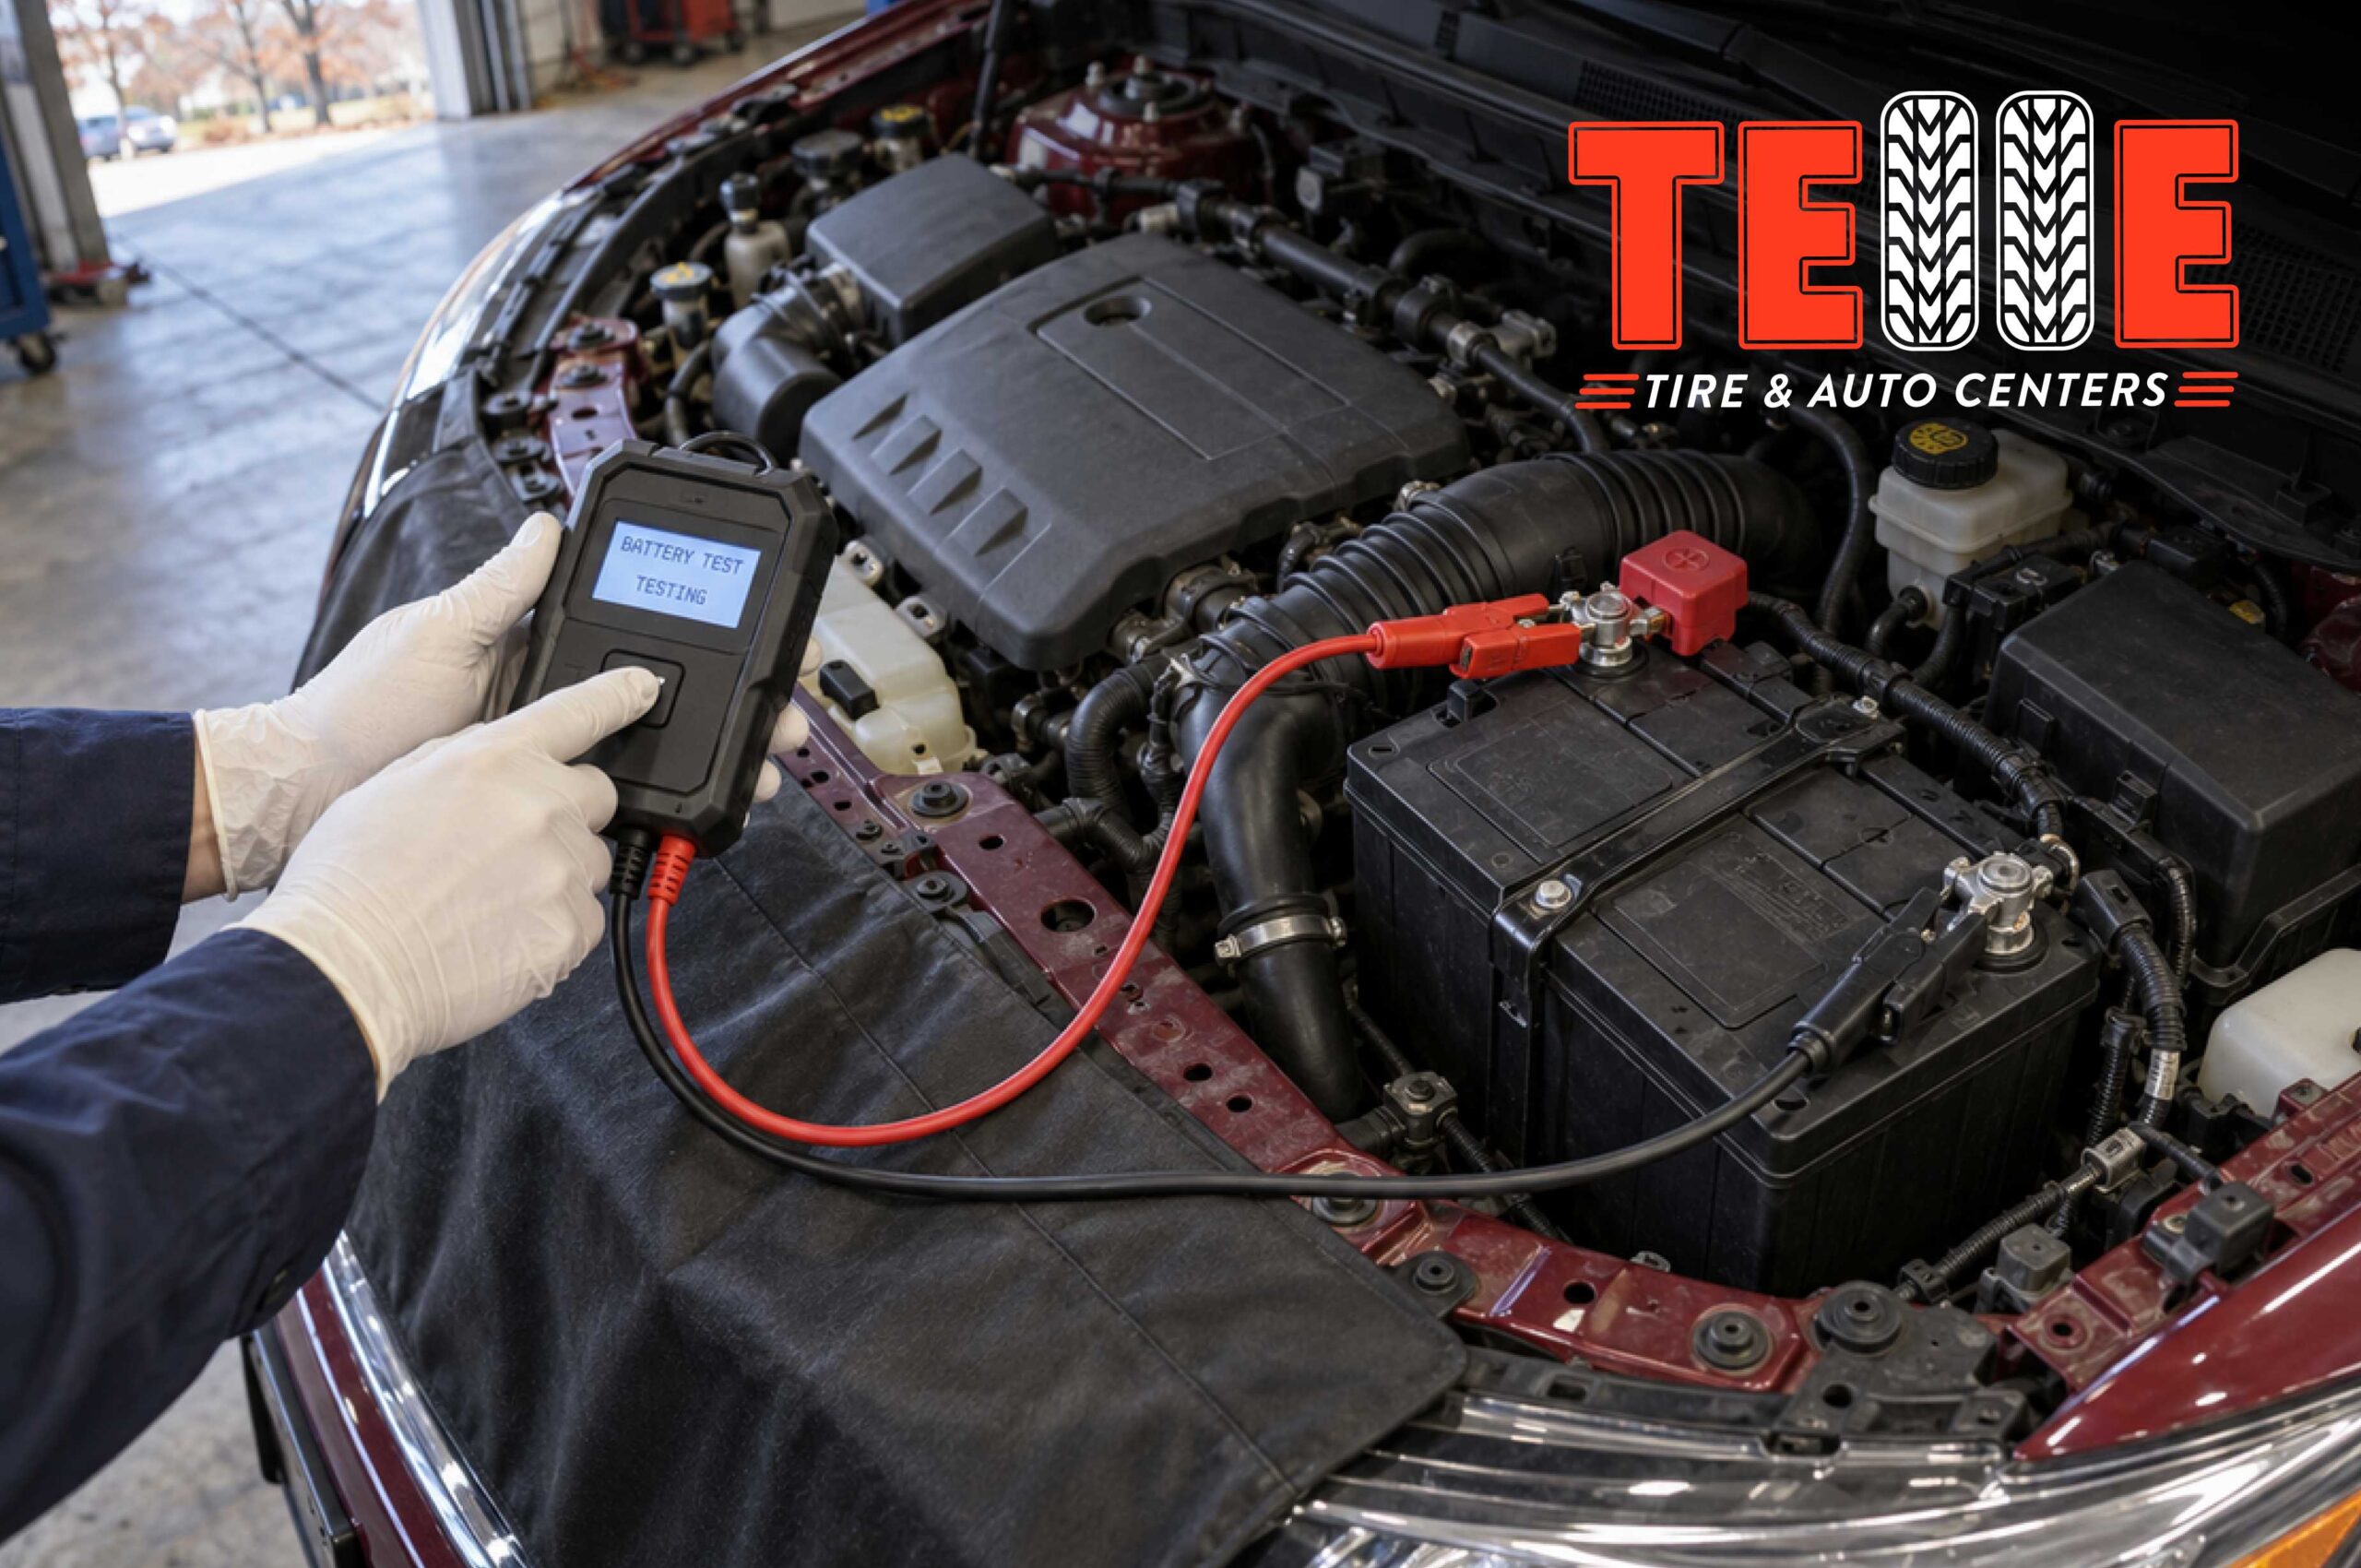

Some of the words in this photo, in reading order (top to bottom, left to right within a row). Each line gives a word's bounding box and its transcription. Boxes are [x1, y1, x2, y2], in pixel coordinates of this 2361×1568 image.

[620, 535, 695, 565] BATTERY
[702, 552, 745, 576] TEST
[635, 574, 708, 606] TESTING
